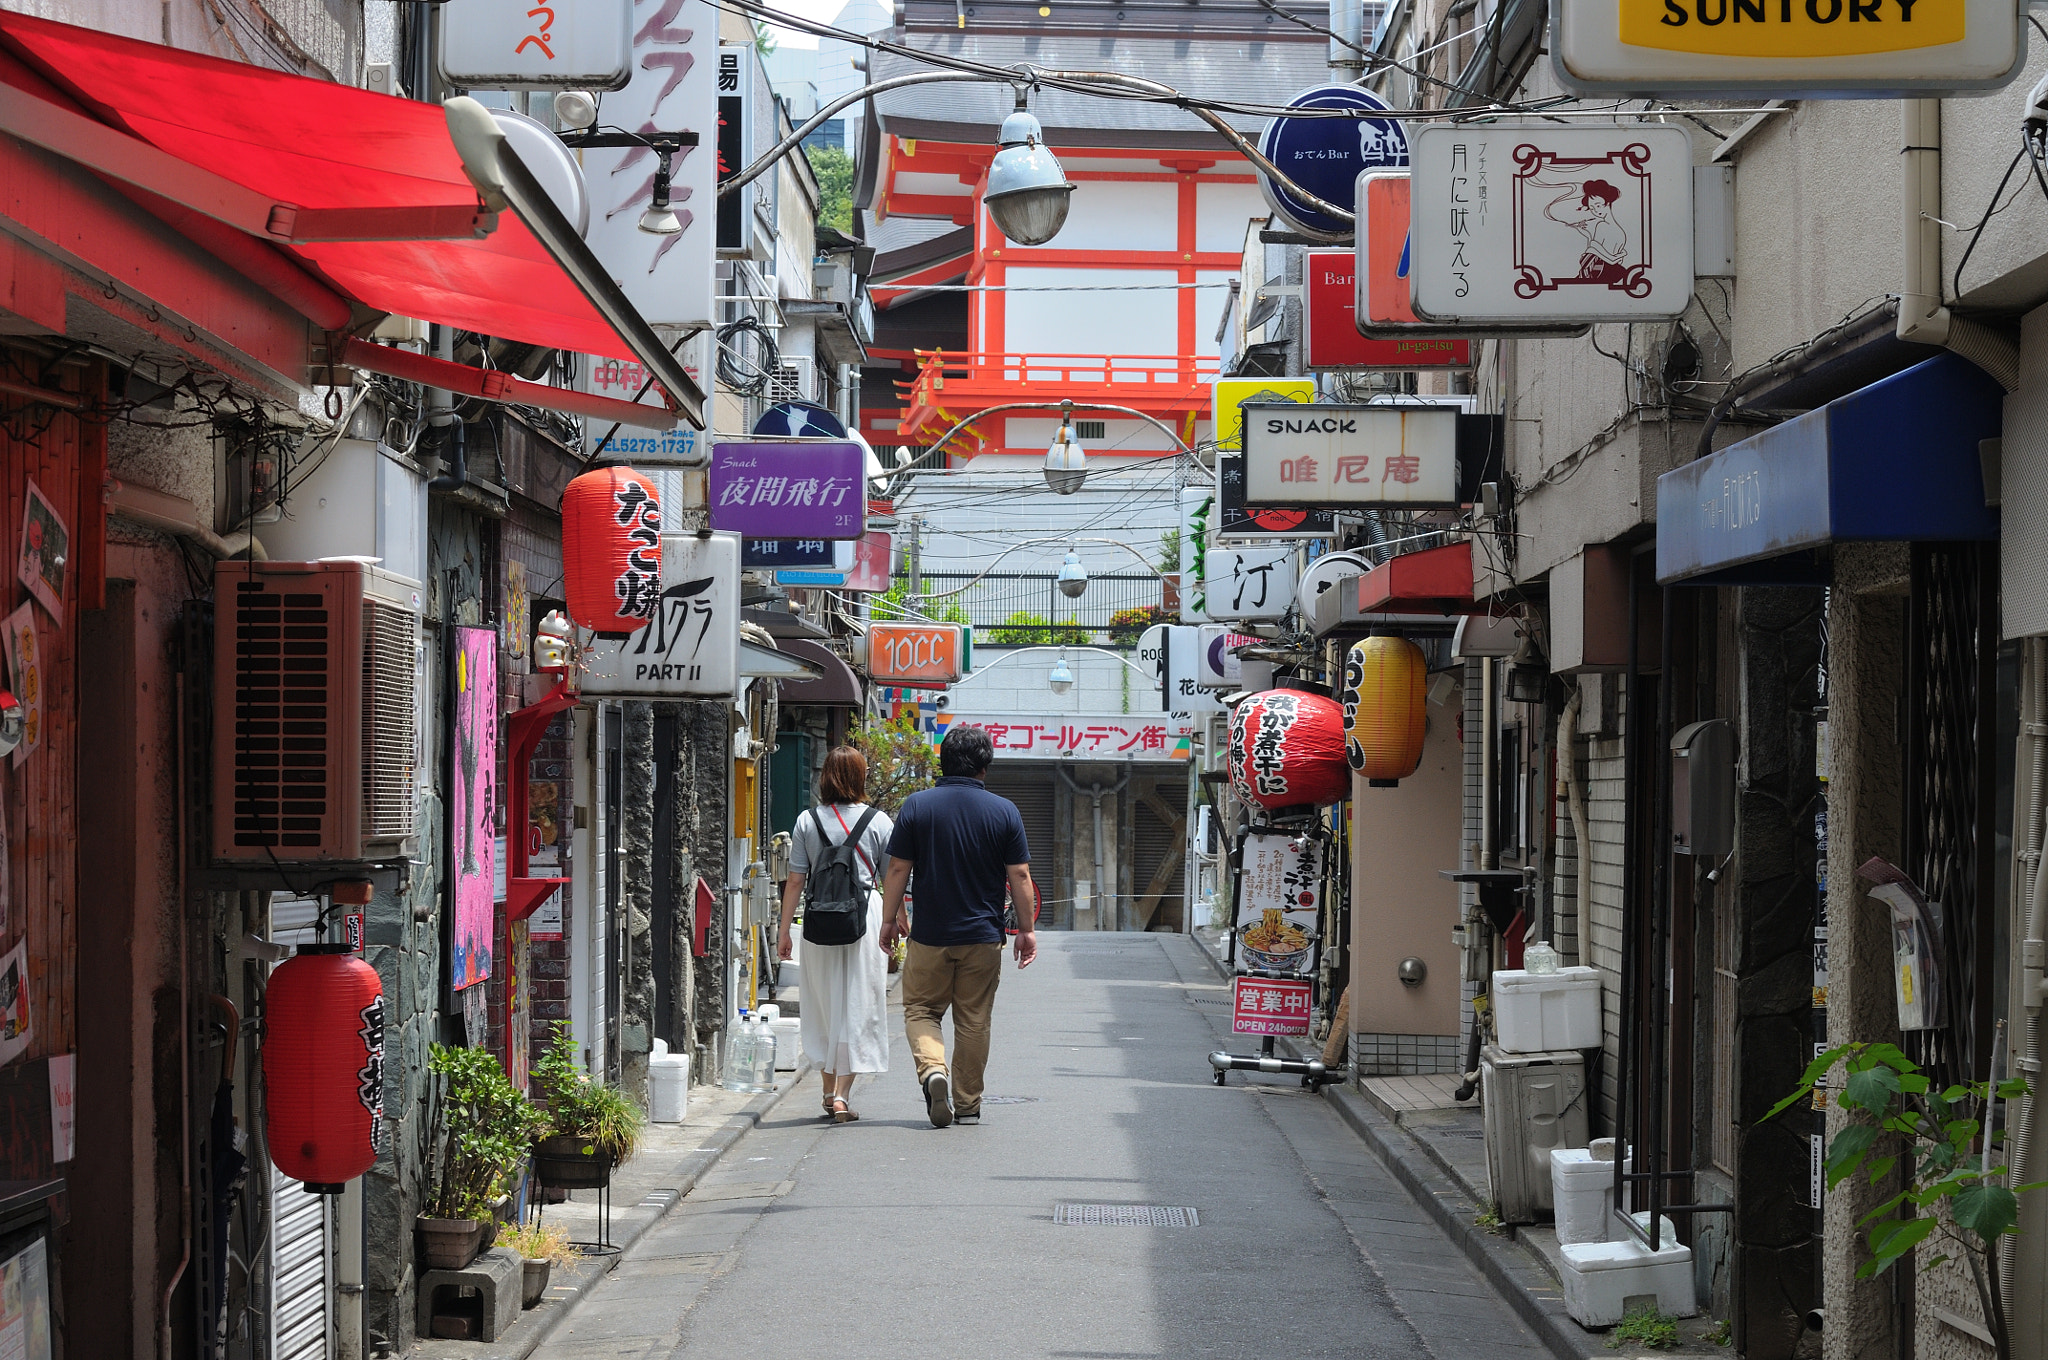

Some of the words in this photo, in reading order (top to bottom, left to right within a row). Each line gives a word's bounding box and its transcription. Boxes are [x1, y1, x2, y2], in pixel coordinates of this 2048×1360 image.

[1660, 0, 1918, 26] SUNTORY
[1294, 149, 1327, 160] おでん
[1328, 149, 1350, 160] Bar
[1450, 144, 1471, 298] 月に吠える
[1324, 271, 1355, 286] Bar
[1267, 418, 1357, 434] SNACK
[720, 456, 757, 470] Snack
[1279, 454, 1420, 484] 唯尼庵
[719, 476, 853, 508] 夜間飛行
[1723, 470, 1761, 531] 月に吠える
[835, 514, 853, 526] 2F
[1233, 554, 1275, 611] 汀
[884, 633, 945, 675] 10CC
[636, 664, 685, 681] PART
[957, 721, 1167, 751] 宿ゴールデン街
[1253, 695, 1300, 795] 我が煮干に
[1239, 988, 1309, 1014] 営業中!
[1236, 1020, 1266, 1032] OPEN
[1268, 1022, 1307, 1034] 24hours
